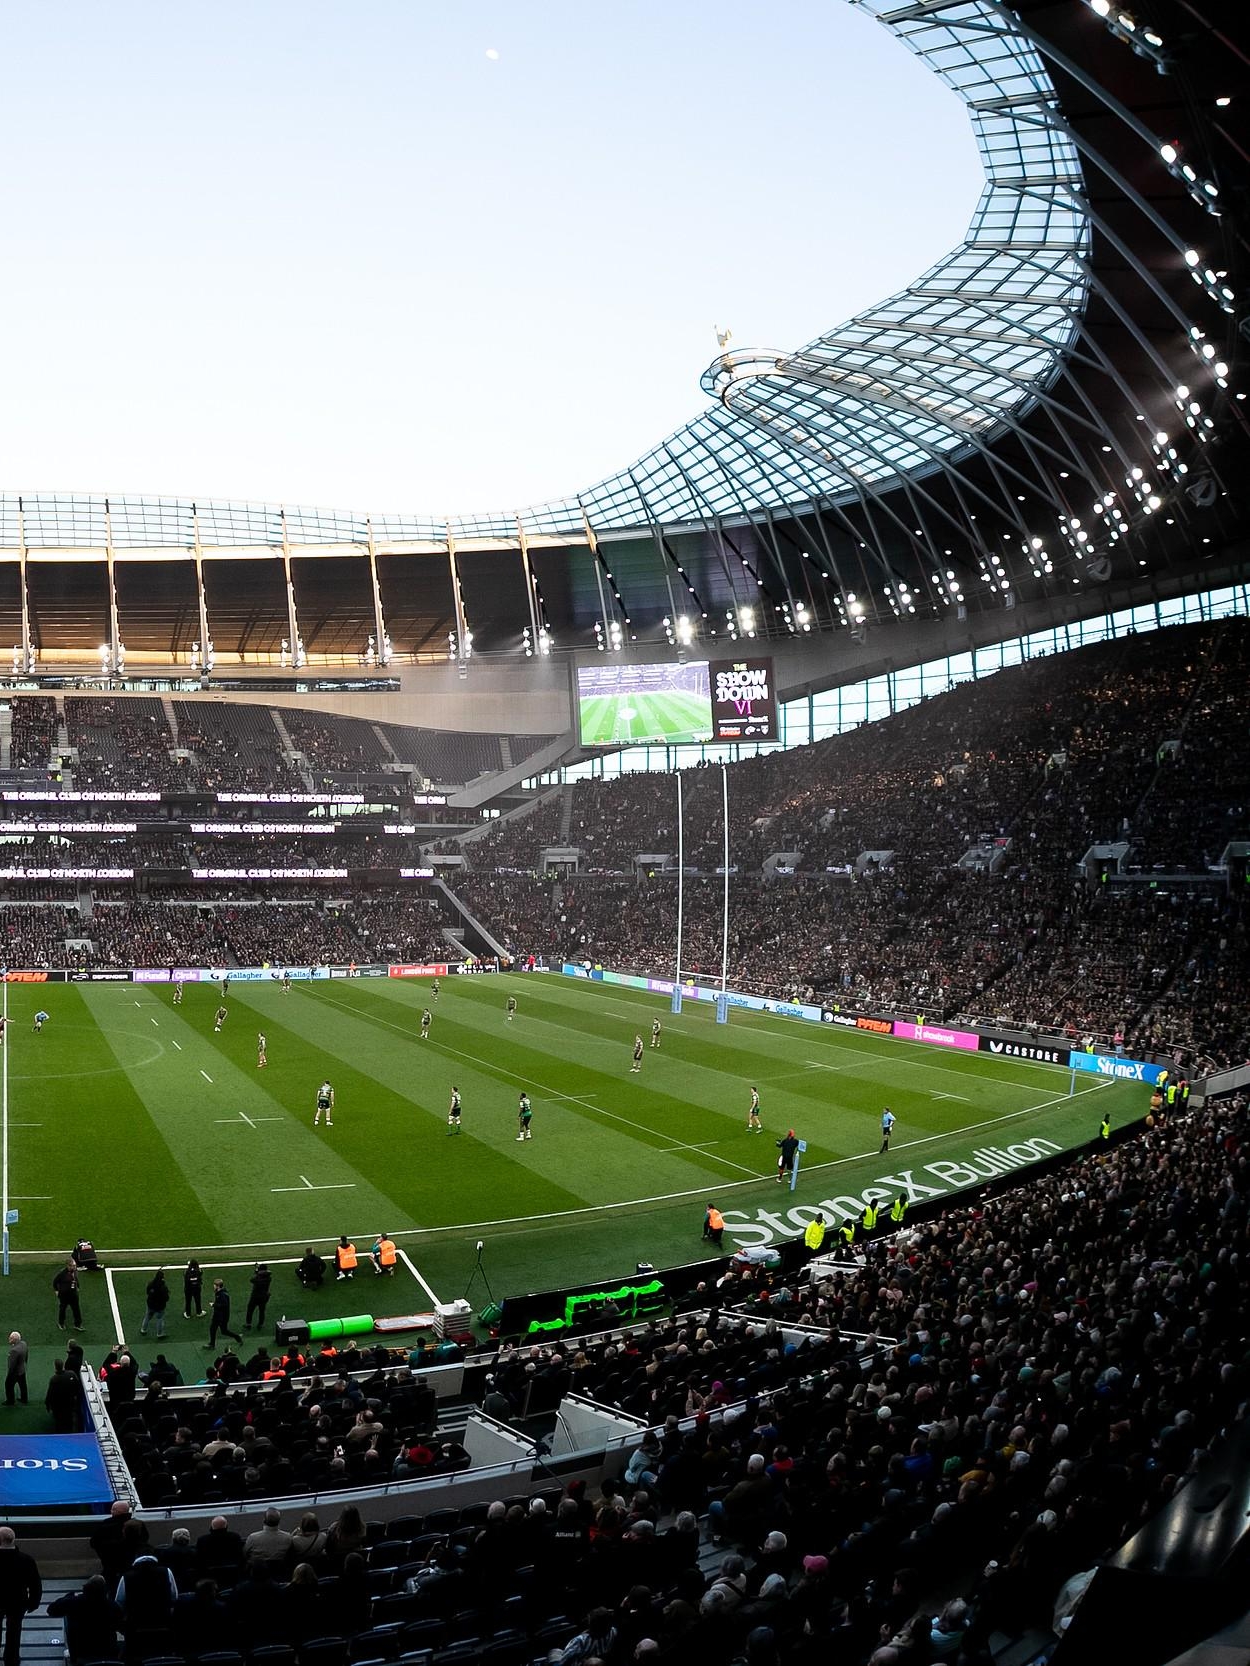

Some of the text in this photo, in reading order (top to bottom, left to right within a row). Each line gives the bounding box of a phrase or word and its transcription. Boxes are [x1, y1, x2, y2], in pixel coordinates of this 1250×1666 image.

[733, 663, 747, 671] THE
[716, 670, 766, 687] SHOW
[716, 685, 768, 702] DOWN
[734, 701, 752, 715] VI
[145, 971, 170, 980] Fundin
[288, 971, 321, 979] Gallager
[776, 1005, 803, 1017] Gallagher
[834, 1015, 857, 1025] Gallagher
[1006, 1044, 1059, 1062] CASTORE
[1096, 1057, 1145, 1080] StoneX
[722, 1136, 1062, 1247] StoneX Bullion
